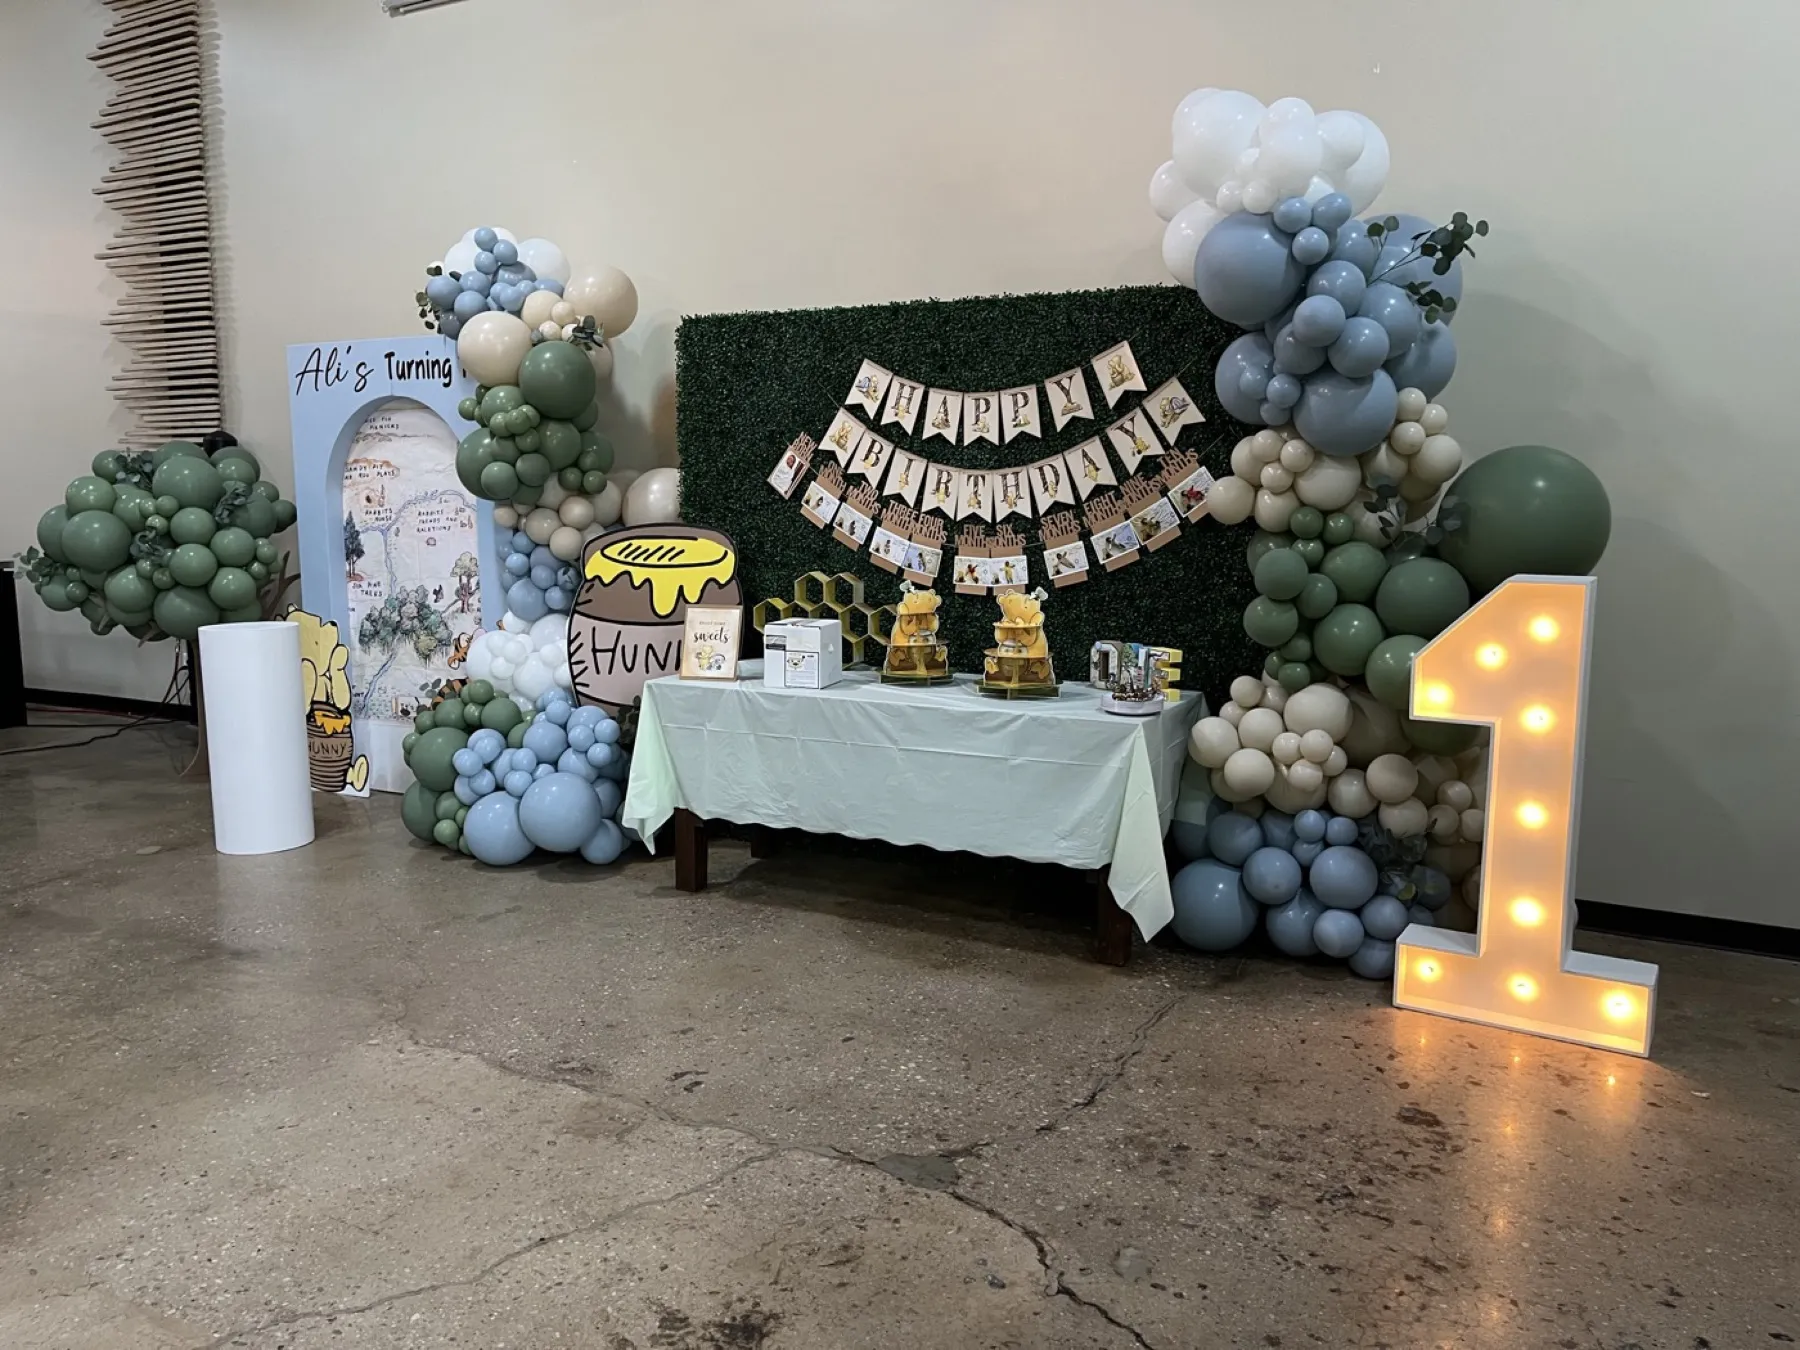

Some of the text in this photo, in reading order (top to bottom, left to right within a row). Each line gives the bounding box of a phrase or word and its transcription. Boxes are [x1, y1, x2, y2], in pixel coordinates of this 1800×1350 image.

[296, 346, 452, 395] Ali's Turning
[893, 373, 1083, 432] HAPPY
[860, 414, 1144, 507] BIRTHDAY
[1158, 447, 1185, 469] TEN
[859, 481, 880, 500] TWO
[889, 500, 919, 520] THREE
[1083, 492, 1116, 514] EIGHT
[917, 513, 944, 529] FOUR
[1040, 510, 1074, 528] SEVEN
[963, 524, 986, 536] FIVE
[996, 524, 1015, 536] SIX
[1038, 521, 1081, 541] MONTHS
[693, 626, 731, 644] sweets
[1393, 573, 1659, 1058] 1
